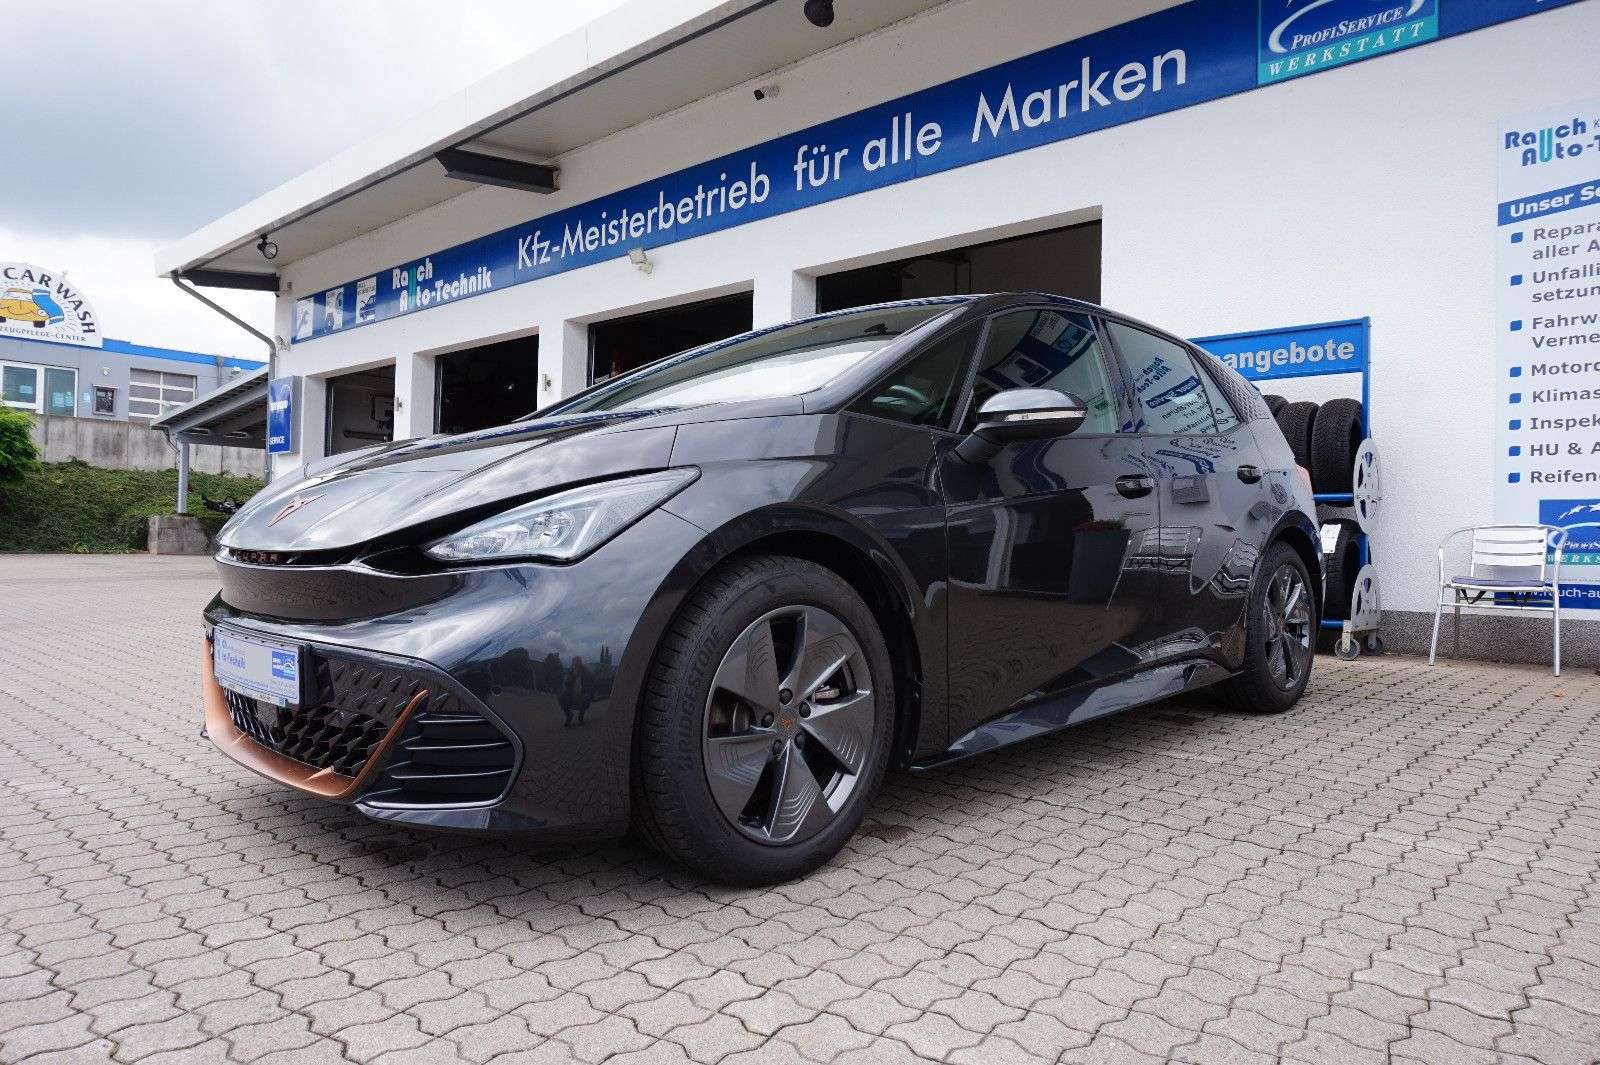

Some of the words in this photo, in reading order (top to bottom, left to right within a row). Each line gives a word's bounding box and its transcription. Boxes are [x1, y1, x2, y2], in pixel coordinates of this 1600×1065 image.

[1267, 21, 1424, 77] WERKSTATT
[1504, 117, 1587, 156] Rauch
[517, 161, 770, 270] Kfz-Meisterbetrieb
[792, 143, 849, 192] für
[862, 111, 942, 172] alle
[970, 47, 1187, 144] Marken
[1509, 191, 1576, 219] Unser
[1532, 242, 1580, 260] aller
[3, 266, 52, 288] CAR
[56, 282, 96, 334] WASH
[399, 266, 493, 313] Auto-Technik
[1532, 313, 1600, 331] Fahrw
[1213, 339, 1355, 373] angebote
[1530, 332, 1600, 349] Verme
[1530, 413, 1600, 431] Inspek
[1530, 443, 1559, 457] HU
[1567, 442, 1582, 455] &
[1529, 469, 1600, 484] Reifen
[677, 624, 724, 771] BRIDGESTONE
